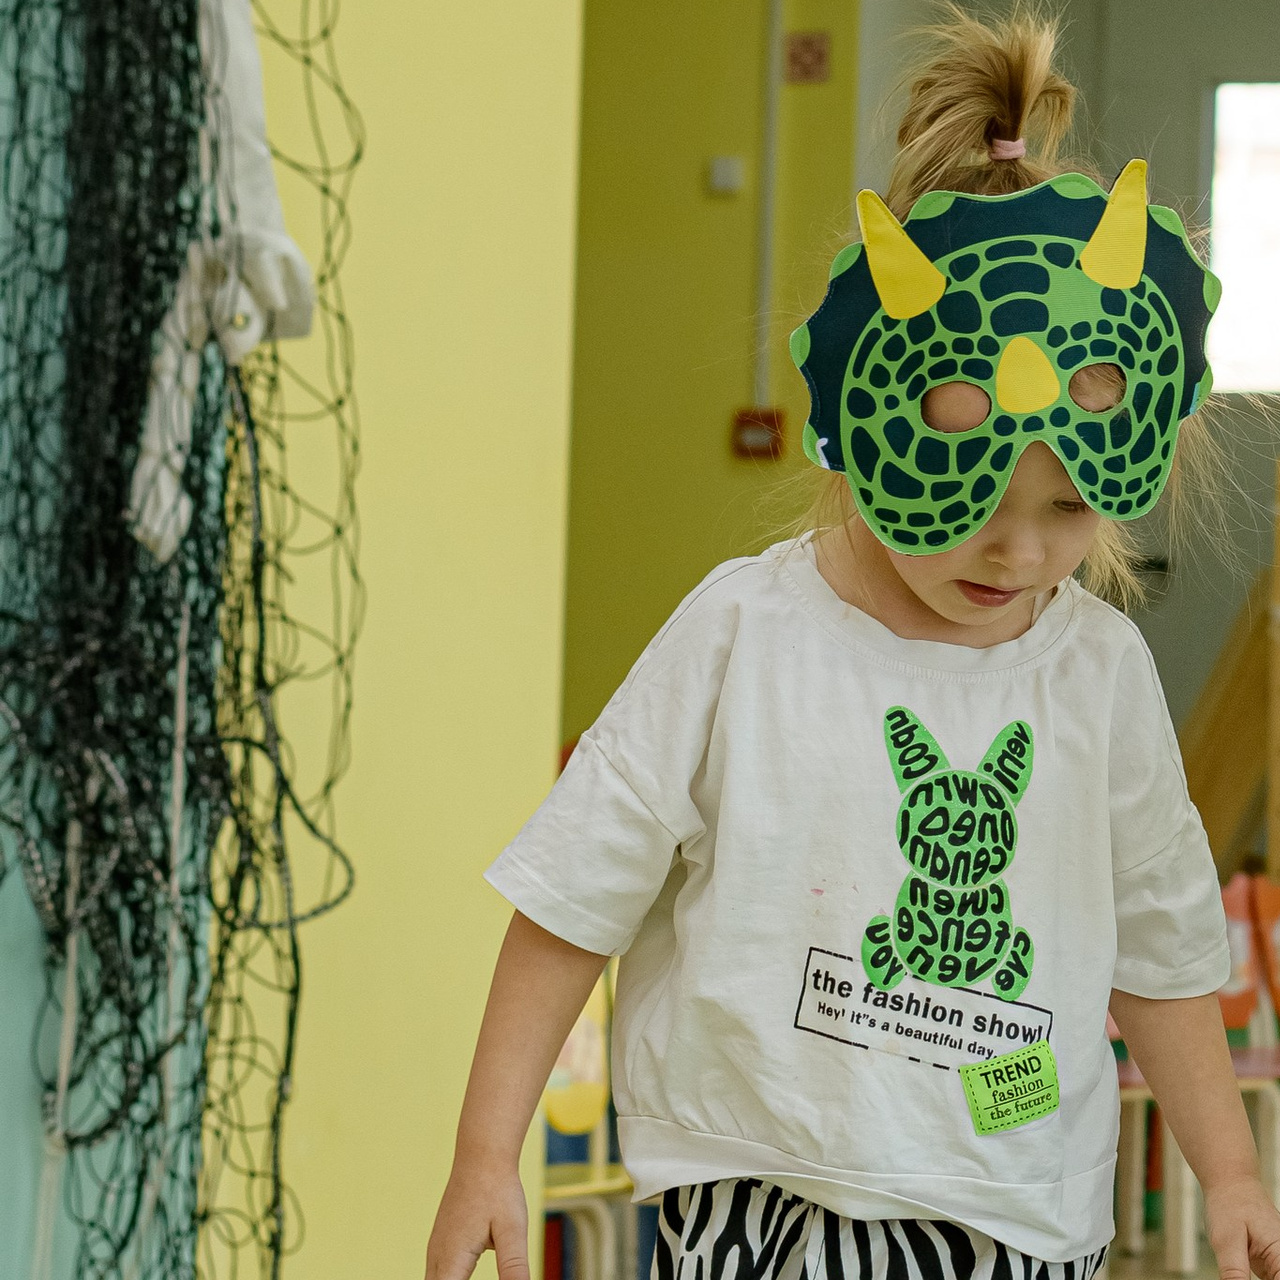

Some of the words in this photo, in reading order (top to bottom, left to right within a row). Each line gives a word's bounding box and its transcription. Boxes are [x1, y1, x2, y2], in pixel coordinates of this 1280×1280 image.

[812, 969, 853, 998] the
[862, 981, 964, 1027] fashion
[880, 1021, 890, 1032] a
[895, 1022, 963, 1051] beautiful
[980, 1055, 1042, 1090] TREND
[989, 1105, 1012, 1121] the
[1014, 1090, 1053, 1115] future
[991, 1077, 1044, 1104] fashion
